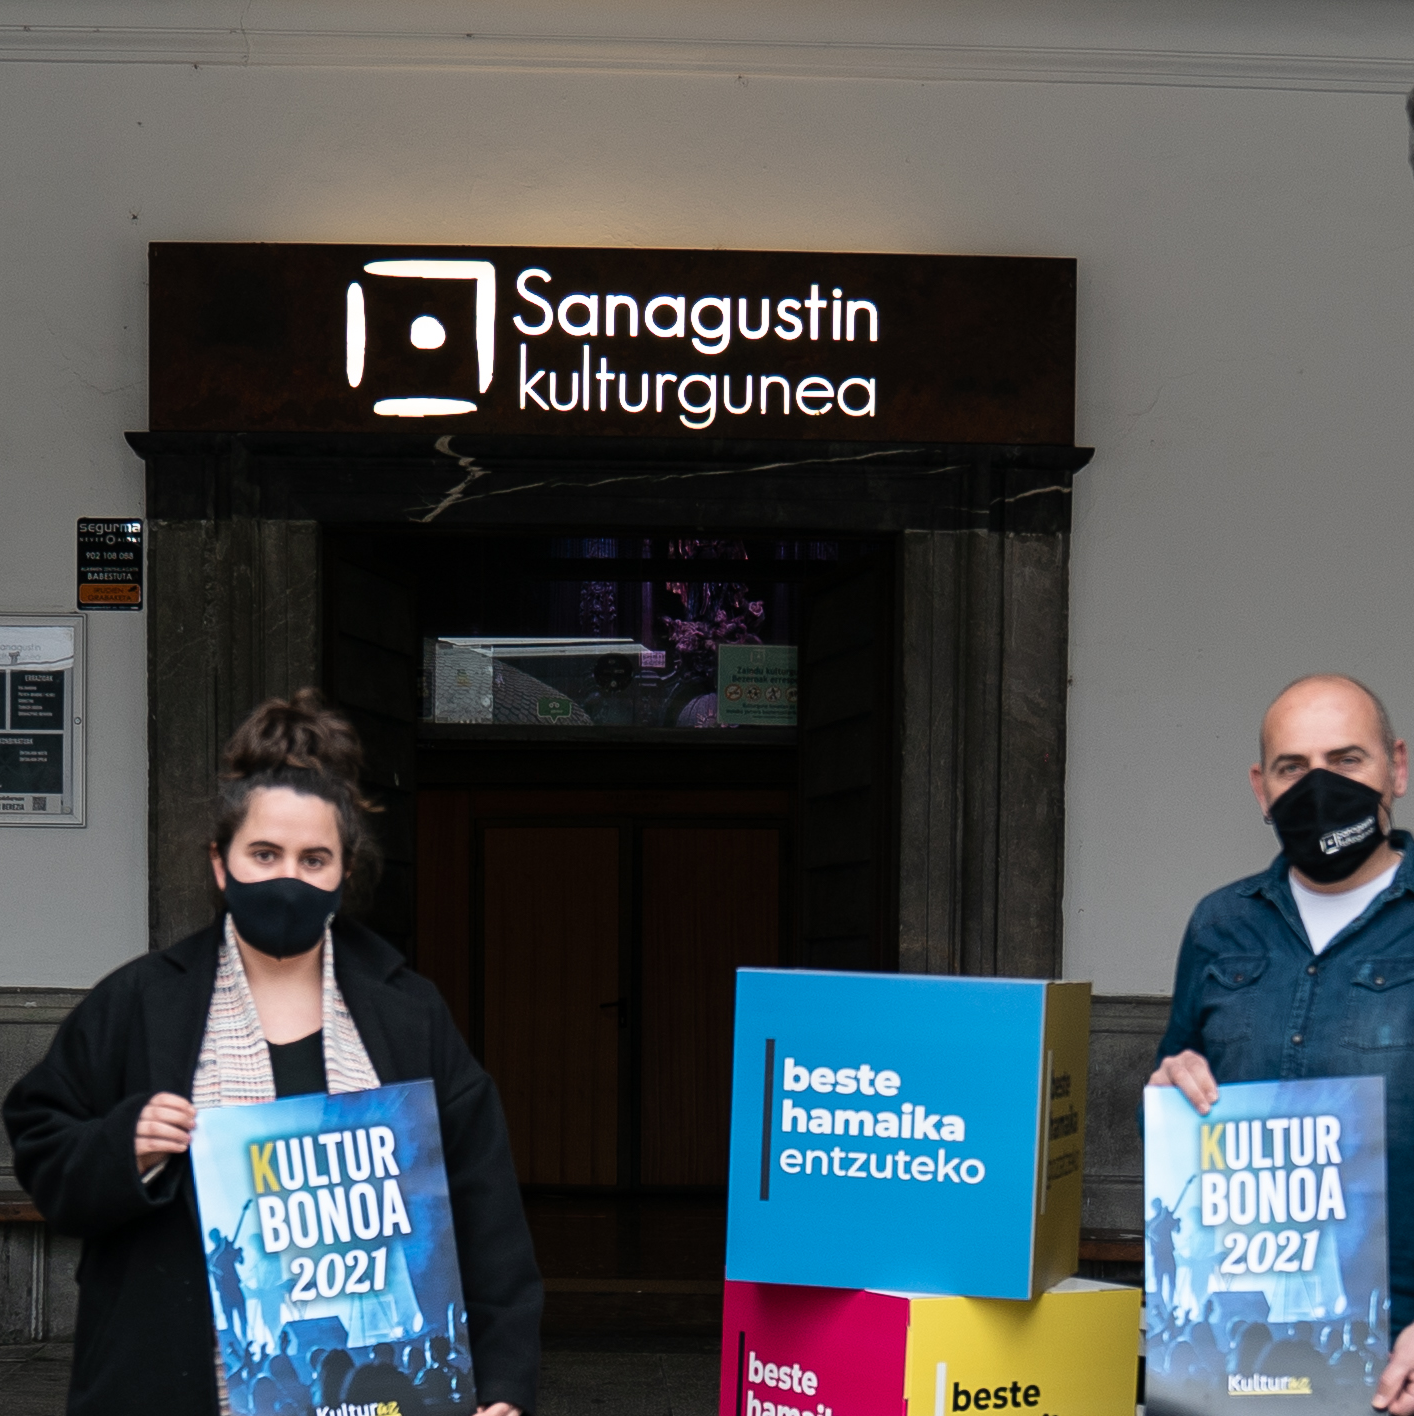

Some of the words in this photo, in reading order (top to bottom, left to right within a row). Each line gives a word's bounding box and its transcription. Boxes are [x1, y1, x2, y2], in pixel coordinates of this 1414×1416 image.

[512, 268, 879, 356] Sanagustin
[518, 342, 877, 430] kulturgunea
[79, 523, 141, 534] segurma
[86, 552, 101, 560] 902
[103, 552, 117, 560] 108
[783, 1057, 901, 1097] beste
[781, 1099, 965, 1142] hamaika
[1200, 1115, 1342, 1171] KULTUR
[250, 1126, 399, 1194] KULTUR
[779, 1146, 985, 1185] entzuteko
[257, 1178, 412, 1254] BONOA
[1201, 1166, 1347, 1227] BONOA
[290, 1247, 387, 1303] 2021
[1221, 1230, 1320, 1275] 2021
[747, 1351, 818, 1396] beste
[952, 1381, 1041, 1413] beste
